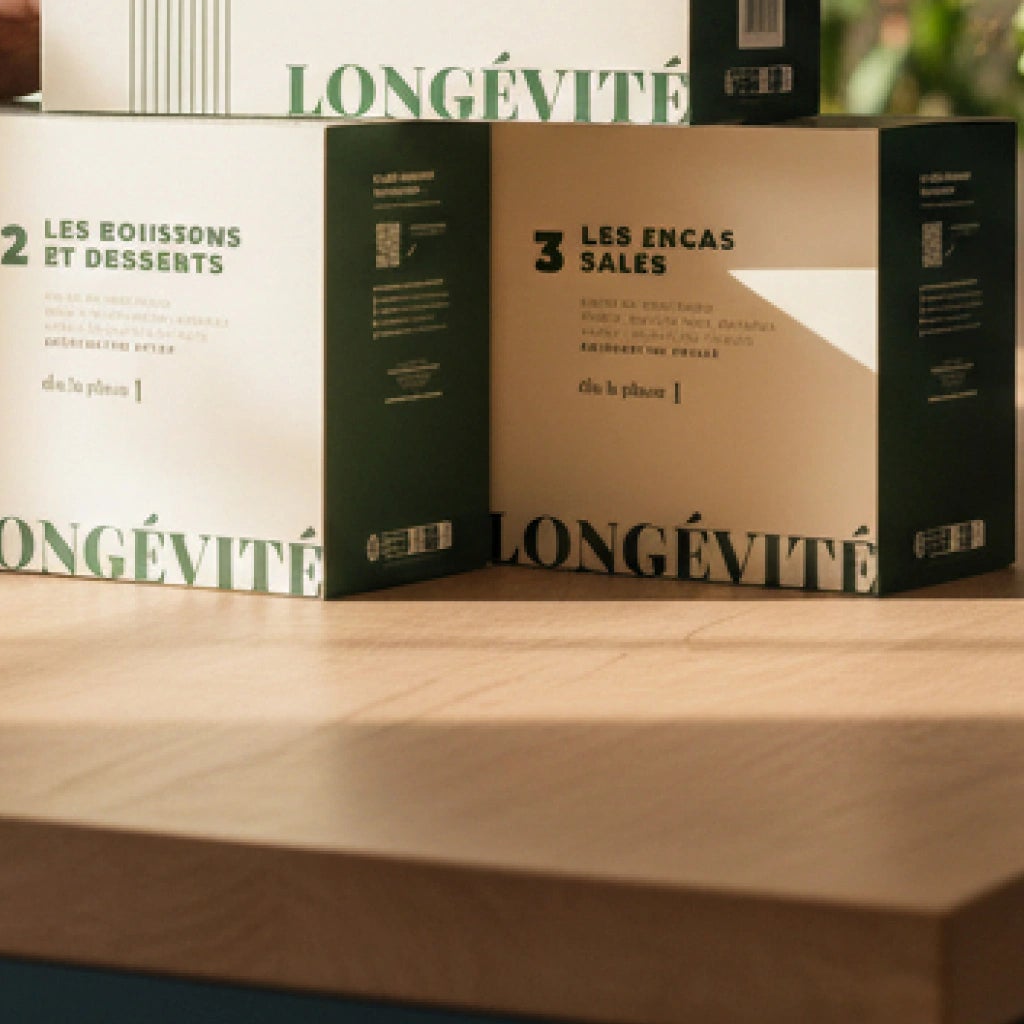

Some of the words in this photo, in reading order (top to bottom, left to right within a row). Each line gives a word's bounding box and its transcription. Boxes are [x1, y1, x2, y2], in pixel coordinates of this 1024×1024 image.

[286, 51, 689, 125] LONGÉVITÉ
[1, 223, 29, 266] 2
[44, 218, 90, 240] LES
[581, 225, 632, 247] LES
[642, 228, 736, 252] ENCAS
[44, 246, 75, 268] ET
[85, 247, 225, 275] DESSERTS
[533, 229, 564, 274] 3
[488, 511, 877, 595] LONGÉVITÉ
